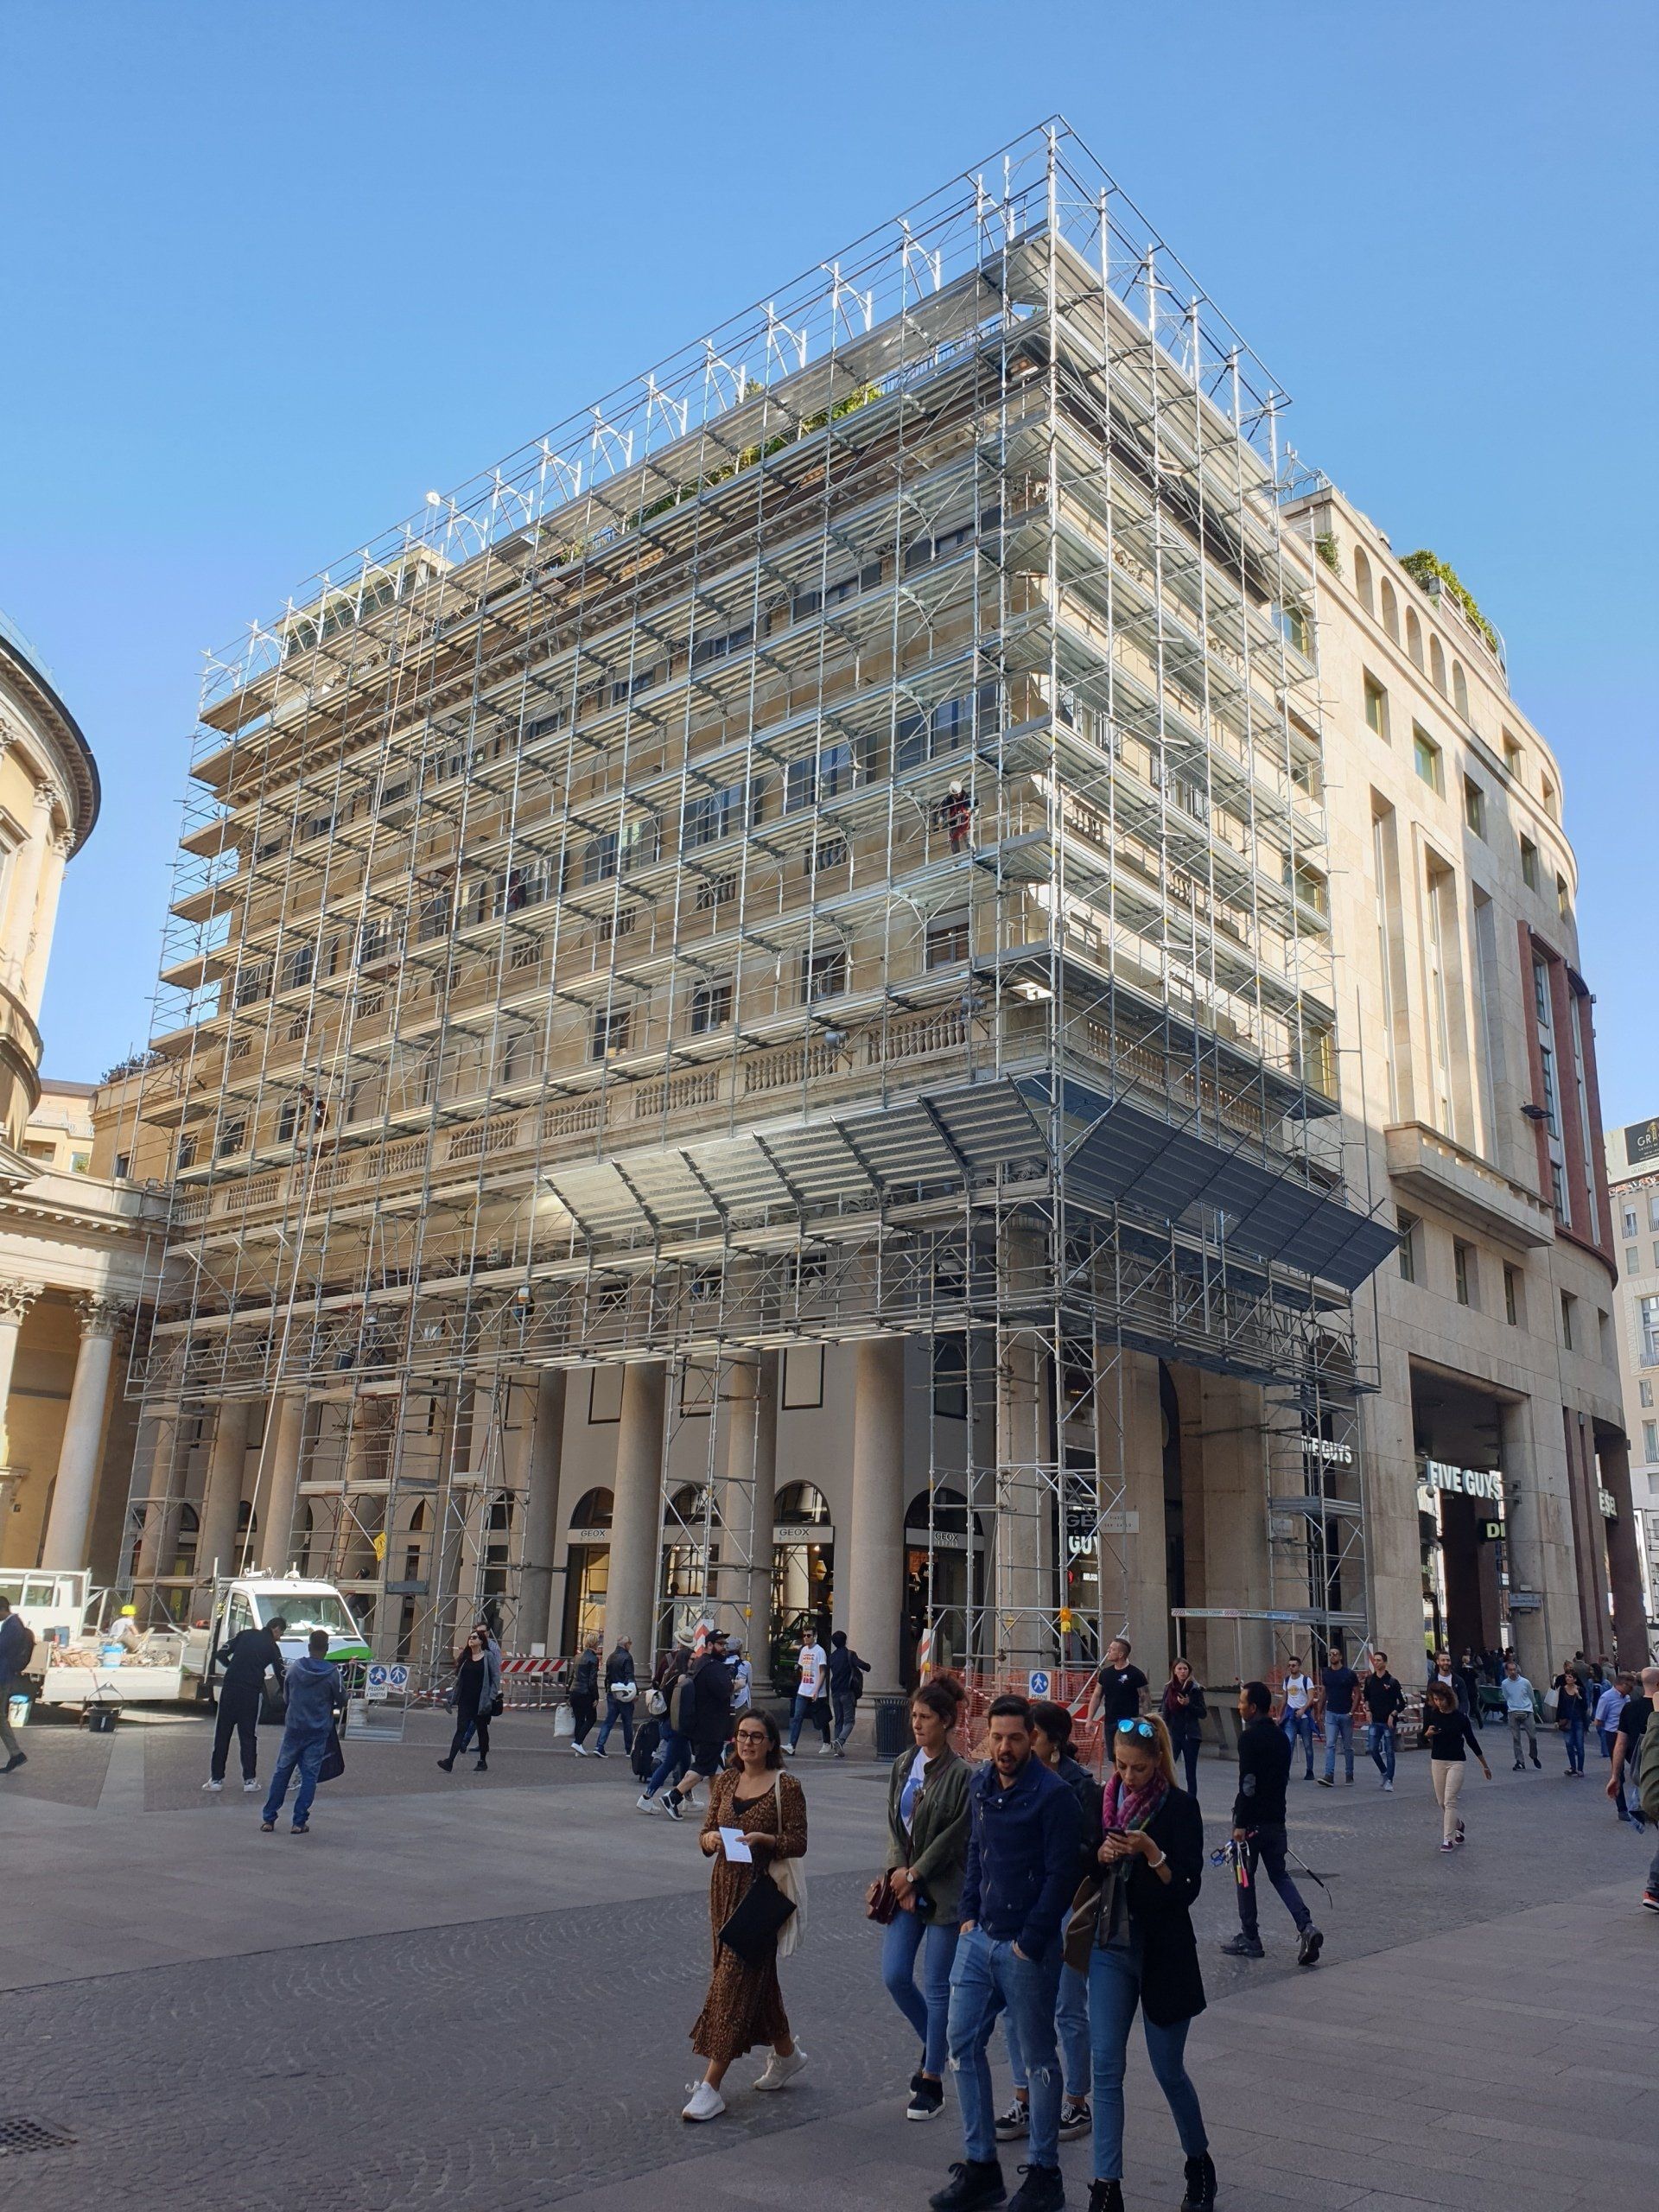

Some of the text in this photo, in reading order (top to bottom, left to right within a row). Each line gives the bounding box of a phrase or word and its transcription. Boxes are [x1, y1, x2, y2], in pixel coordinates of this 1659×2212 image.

[1301, 1435, 1319, 1456] IVE
[1427, 1460, 1502, 1500] FIVE GUYS
[1599, 1491, 1618, 1516] ESEL
[1066, 1514, 1097, 1527] GE
[934, 1532, 958, 1541] GEOX
[1486, 1522, 1506, 1538] DI
